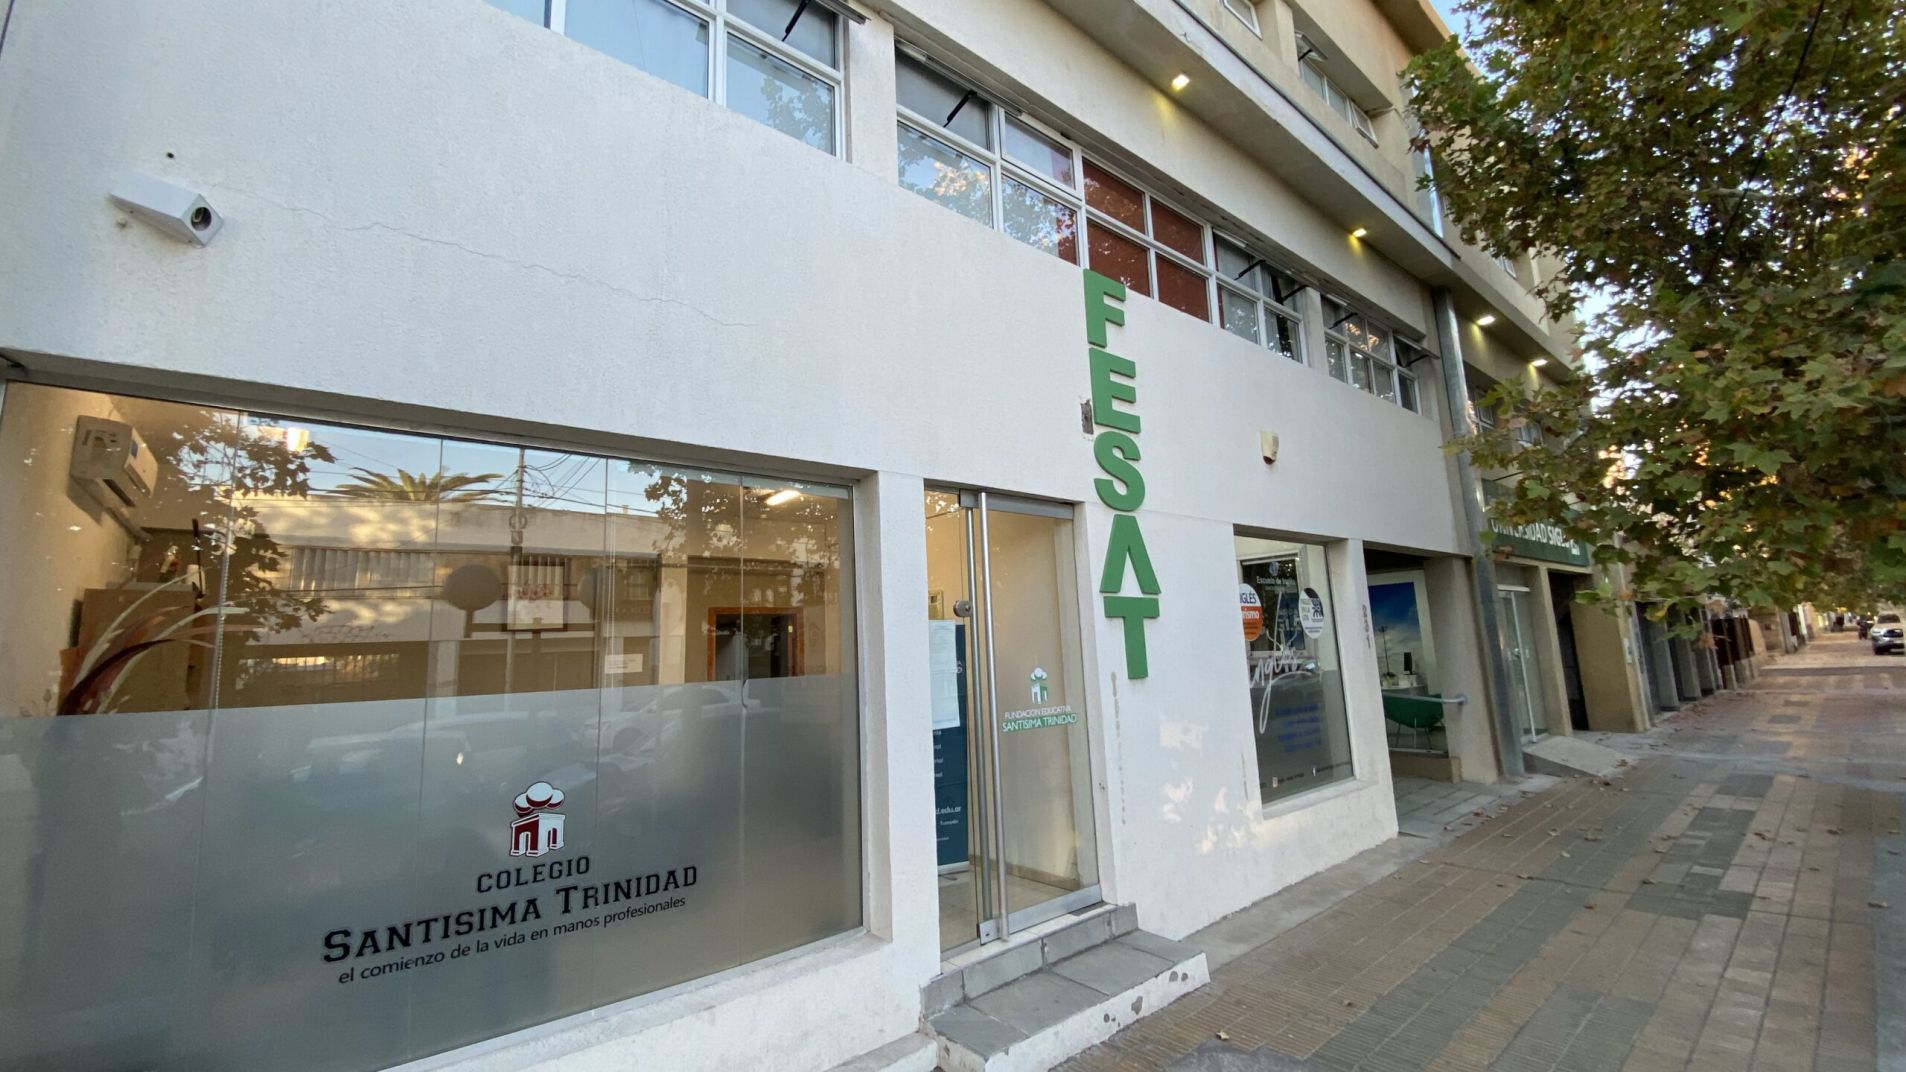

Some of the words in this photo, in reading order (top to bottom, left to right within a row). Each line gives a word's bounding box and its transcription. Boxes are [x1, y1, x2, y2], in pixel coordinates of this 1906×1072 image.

[1083, 268, 1161, 680] FESAT
[1002, 719, 1042, 732] SANTISIMA
[1043, 713, 1078, 726] TRINIDAD
[322, 897, 542, 963] SANTISIMA
[555, 865, 698, 915] TRINIDAD
[476, 855, 590, 893] COLEGIO
[338, 967, 354, 985] el
[360, 951, 445, 980] comienzo
[449, 944, 471, 960] de
[475, 938, 489, 954] la
[494, 932, 526, 949] vida
[530, 927, 549, 943] en
[553, 916, 600, 936] manos
[603, 895, 686, 929] profesionales
